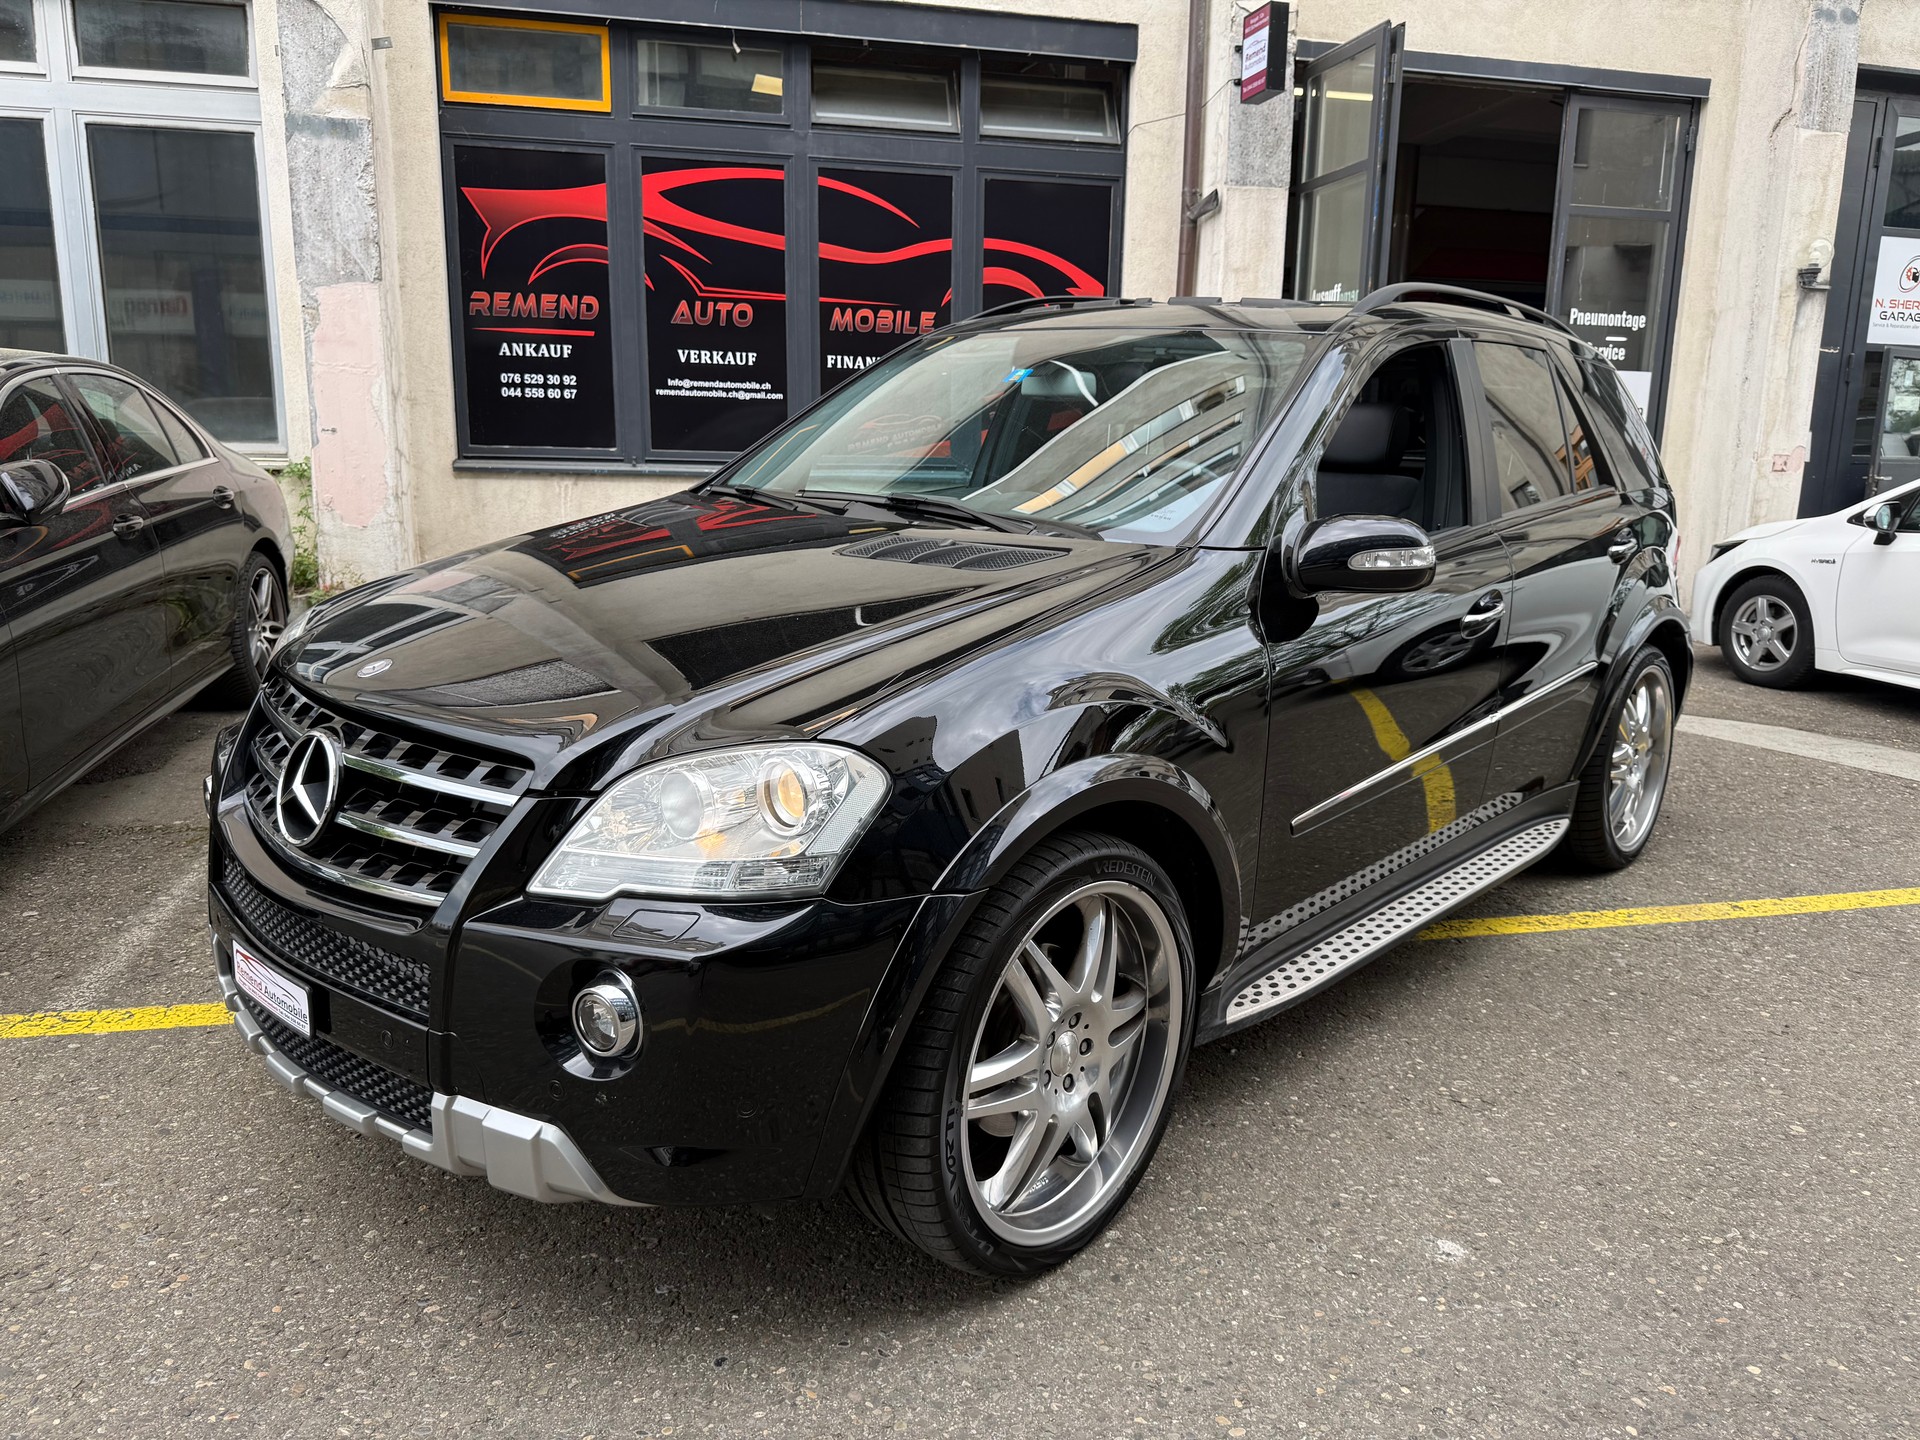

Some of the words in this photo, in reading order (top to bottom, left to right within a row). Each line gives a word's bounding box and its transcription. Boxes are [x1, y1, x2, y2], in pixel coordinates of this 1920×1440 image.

[1875, 298, 1886, 308] N.
[469, 291, 599, 321] REMEND
[671, 299, 754, 328] AUTO
[829, 308, 936, 334] MOBILE
[1569, 307, 1647, 332] Pneumontage
[499, 342, 573, 358] ANKAUF
[677, 349, 757, 366] VERKAUF
[1587, 341, 1626, 361] rvice
[827, 354, 881, 370] FINAN
[500, 372, 522, 384] 076
[523, 373, 545, 385] 529
[546, 374, 561, 386] 30
[562, 374, 578, 386] 92
[501, 386, 522, 398] 044
[524, 387, 546, 399] 558
[547, 388, 562, 399] 60
[563, 388, 578, 400] 67
[655, 388, 784, 401] remendautomobile.ch@gmail.com
[1095, 860, 1157, 887] VREDESTEIN
[264, 985, 308, 1022] Automobile
